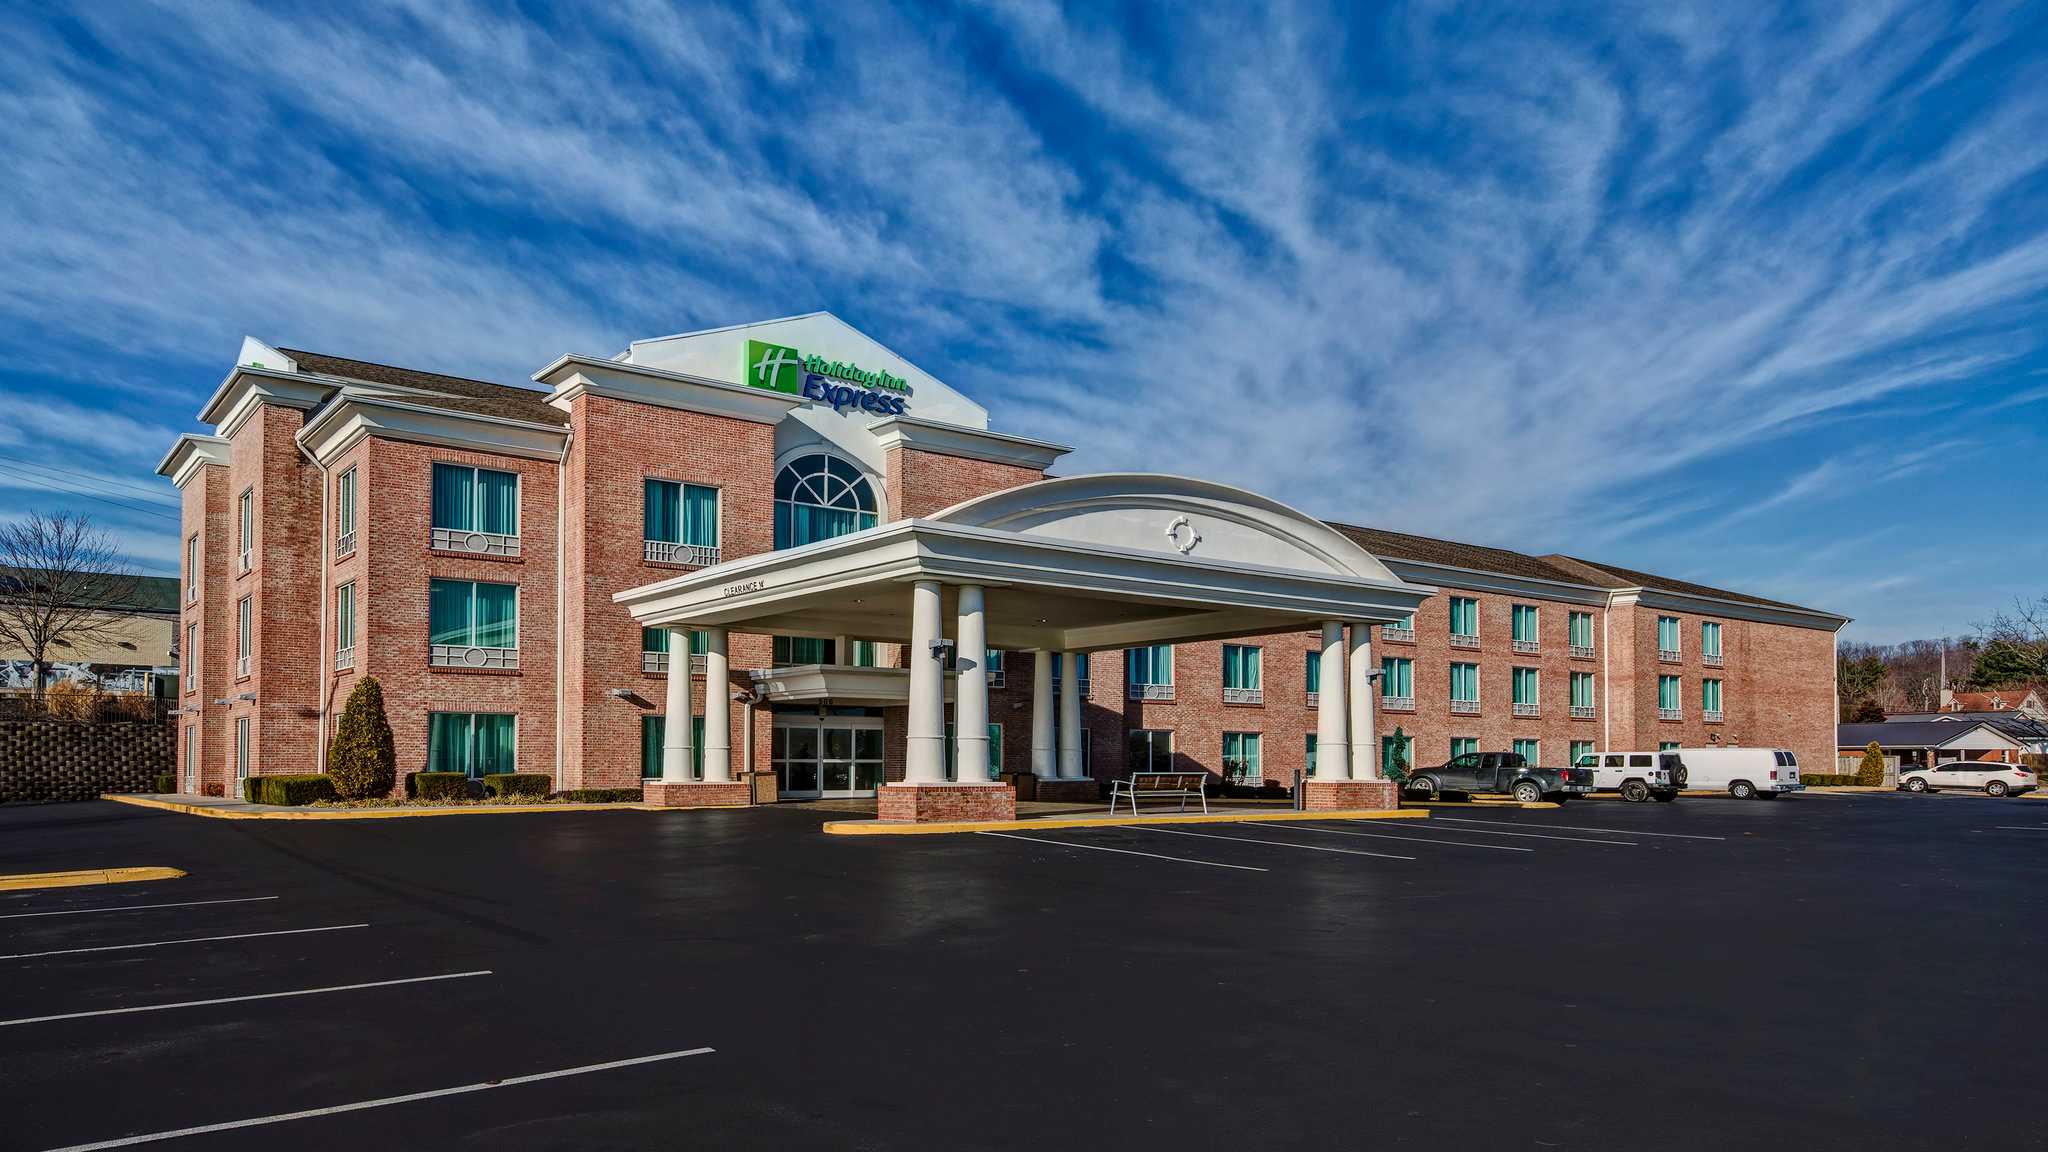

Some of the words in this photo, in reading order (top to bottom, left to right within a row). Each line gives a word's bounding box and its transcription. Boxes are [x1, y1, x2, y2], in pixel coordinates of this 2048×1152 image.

[804, 353, 878, 388] Holiday
[878, 368, 907, 391] Inn
[803, 374, 905, 415] Express
[724, 581, 757, 597] CLEARANCE
